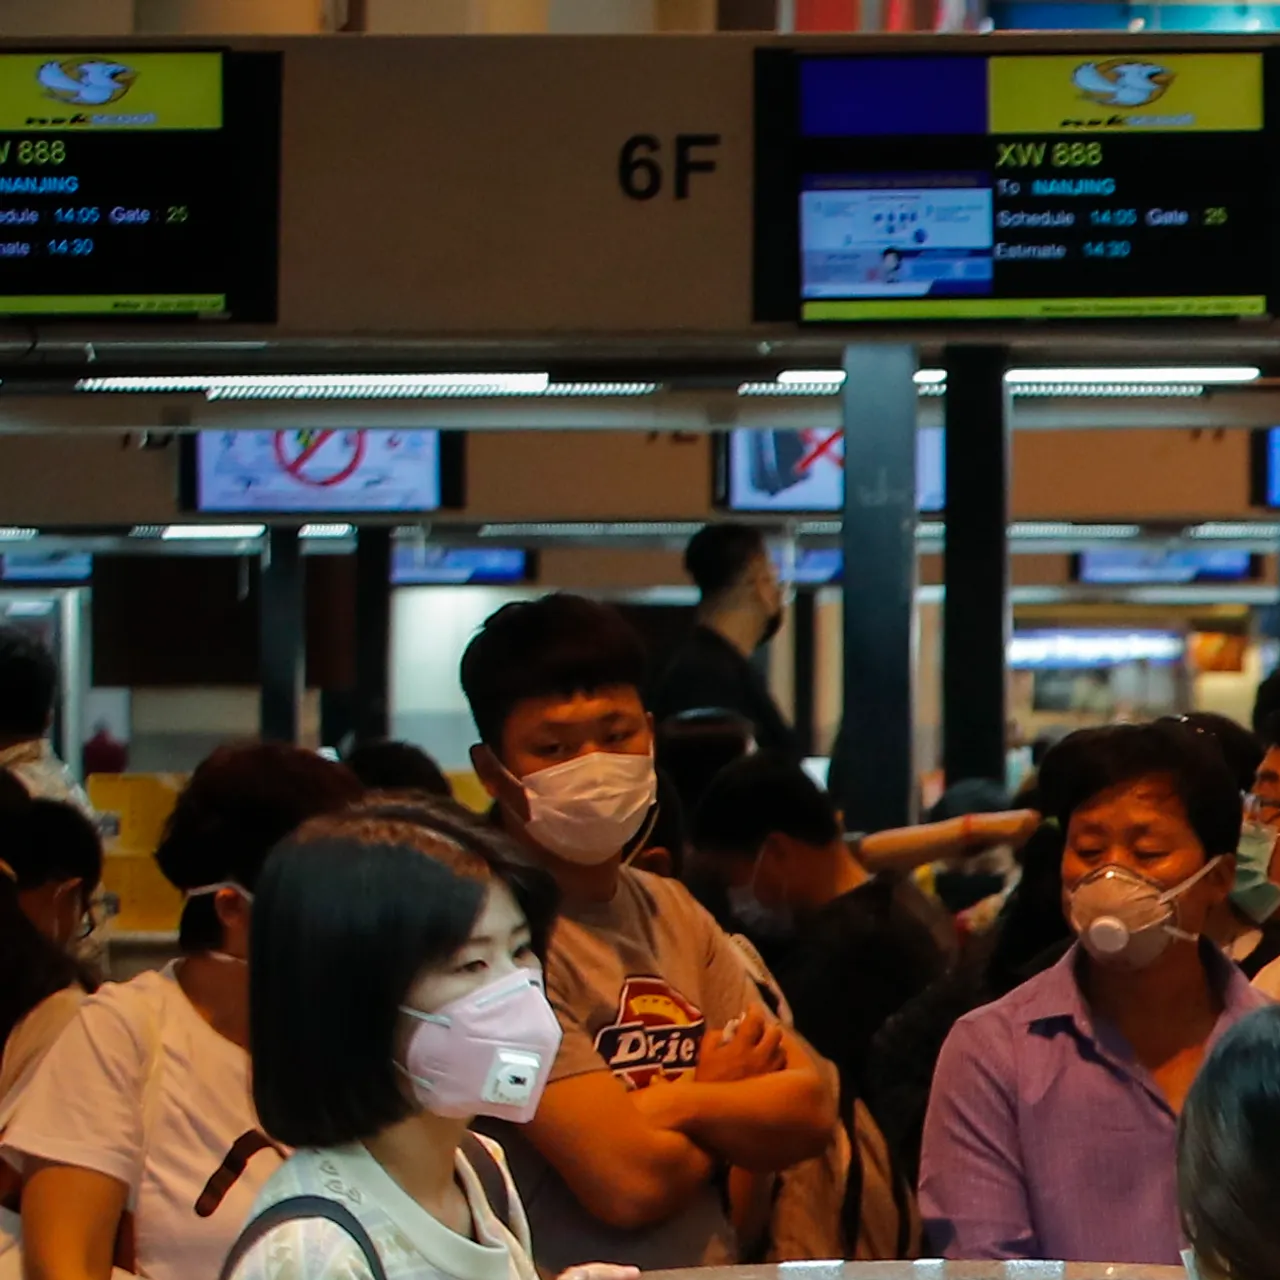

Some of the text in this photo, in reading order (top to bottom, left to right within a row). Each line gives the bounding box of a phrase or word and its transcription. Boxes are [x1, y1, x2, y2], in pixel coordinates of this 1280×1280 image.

[18, 140, 66, 165] 888
[995, 142, 1103, 168] XW 888
[617, 133, 723, 202] 6F
[998, 179, 1020, 196] To
[1032, 178, 1116, 195] NANJING
[54, 207, 100, 223] 14:05
[109, 206, 150, 224] Gate
[999, 210, 1075, 228] Schedule
[1090, 209, 1137, 226] 14:05
[1146, 208, 1188, 227] Gate
[47, 238, 94, 255] 14:30
[994, 242, 1067, 260] Estimate
